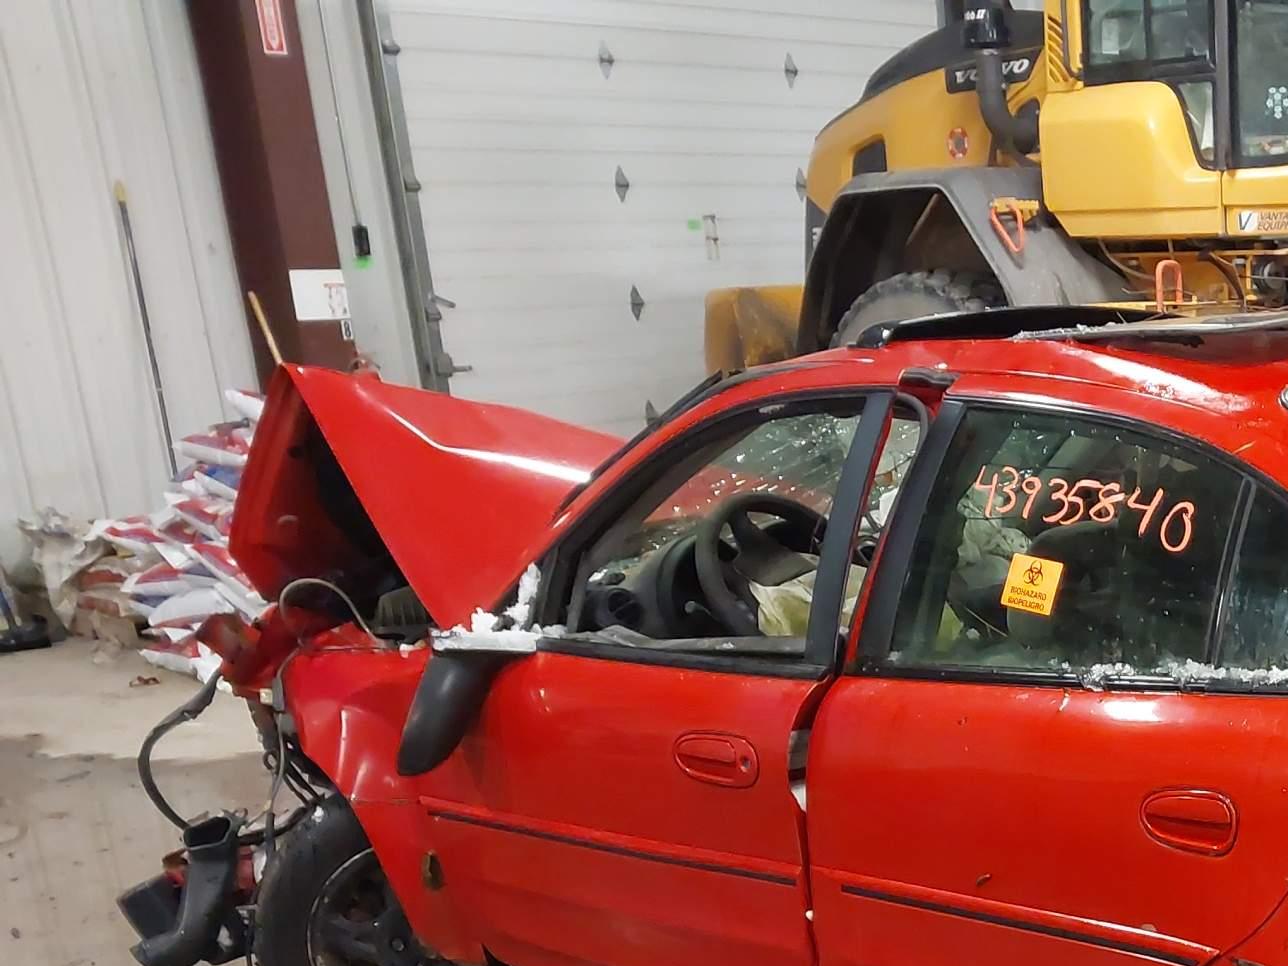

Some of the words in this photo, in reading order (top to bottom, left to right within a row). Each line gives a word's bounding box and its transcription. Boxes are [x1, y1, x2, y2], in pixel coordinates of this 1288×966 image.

[954, 58, 1030, 84] VOVO
[974, 465, 1195, 552] 43935840
[1007, 596, 1045, 612] BIOPELIGRO
[1010, 586, 1047, 601] BIOHAZARD
